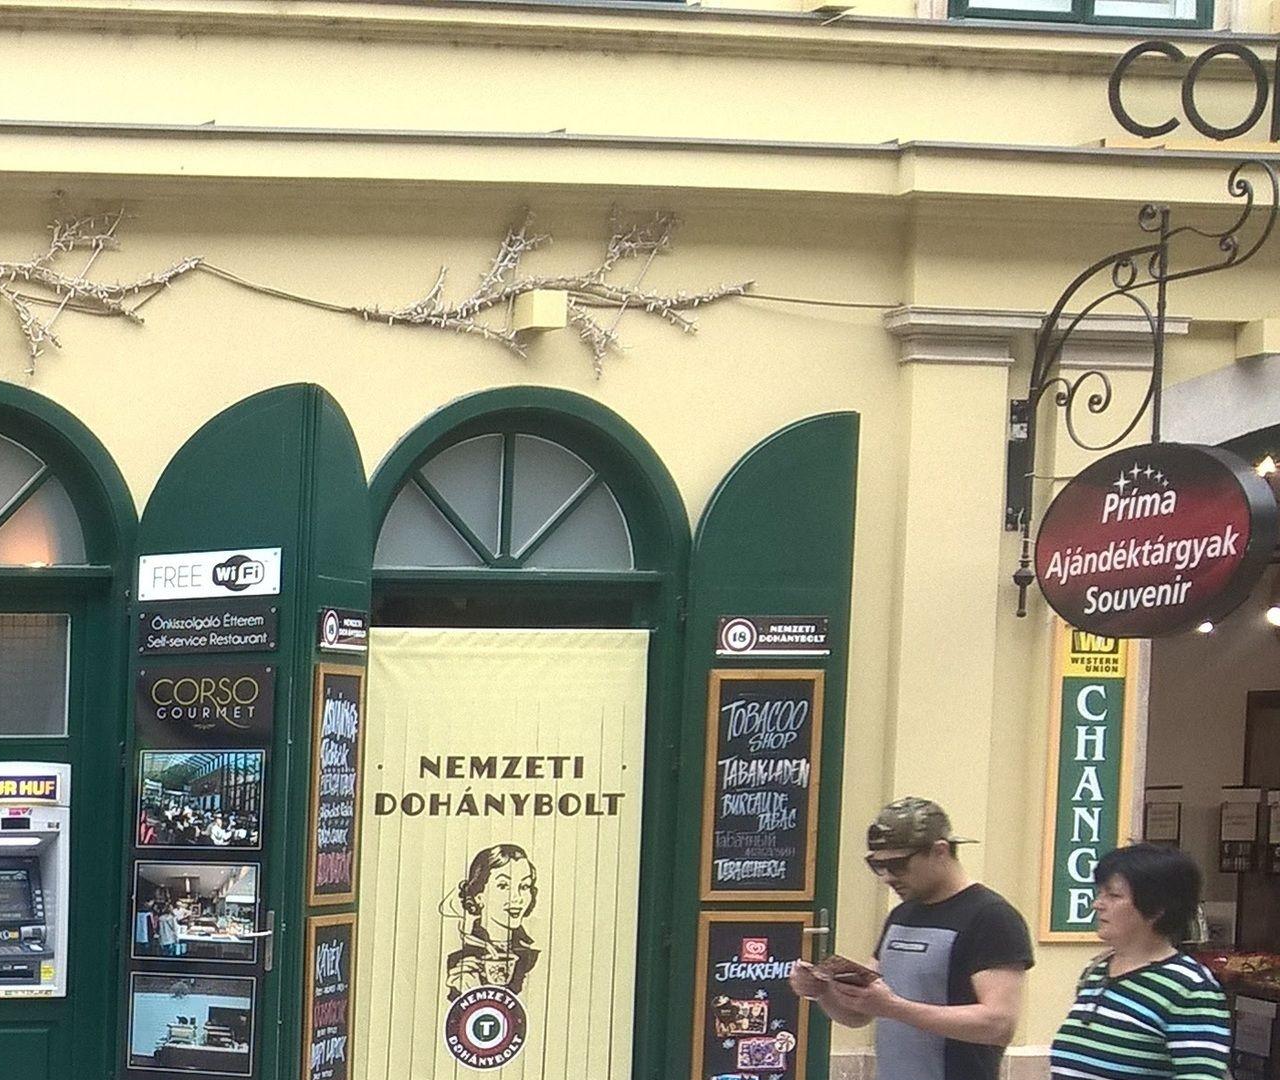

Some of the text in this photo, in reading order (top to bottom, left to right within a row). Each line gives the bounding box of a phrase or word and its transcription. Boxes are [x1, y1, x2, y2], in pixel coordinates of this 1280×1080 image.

[1108, 40, 1280, 143] CO
[1044, 525, 1240, 585] Ajándéktárgyak
[152, 563, 204, 588] FREE
[1083, 575, 1193, 615] Souvenir
[222, 612, 265, 628] Étterem
[146, 631, 269, 649] Self-service Restaurant
[732, 631, 747, 643] 18
[1070, 656, 1119, 664] WESTERN
[151, 676, 259, 706] CORSO
[156, 705, 256, 719] GOURMET
[748, 731, 798, 753] SHOP
[419, 755, 584, 780] NEMZETI
[718, 755, 810, 790] TABAKLADEN
[19, 780, 55, 796] HUF
[374, 786, 626, 817] DOHÁNYBOLT
[1066, 684, 1108, 924] CHANGE
[715, 955, 801, 981] JÉGKRÉME
[459, 990, 516, 1010] NEMZETI
[480, 1021, 495, 1036] T
[448, 1034, 523, 1066] DOHÁNYBOLT
